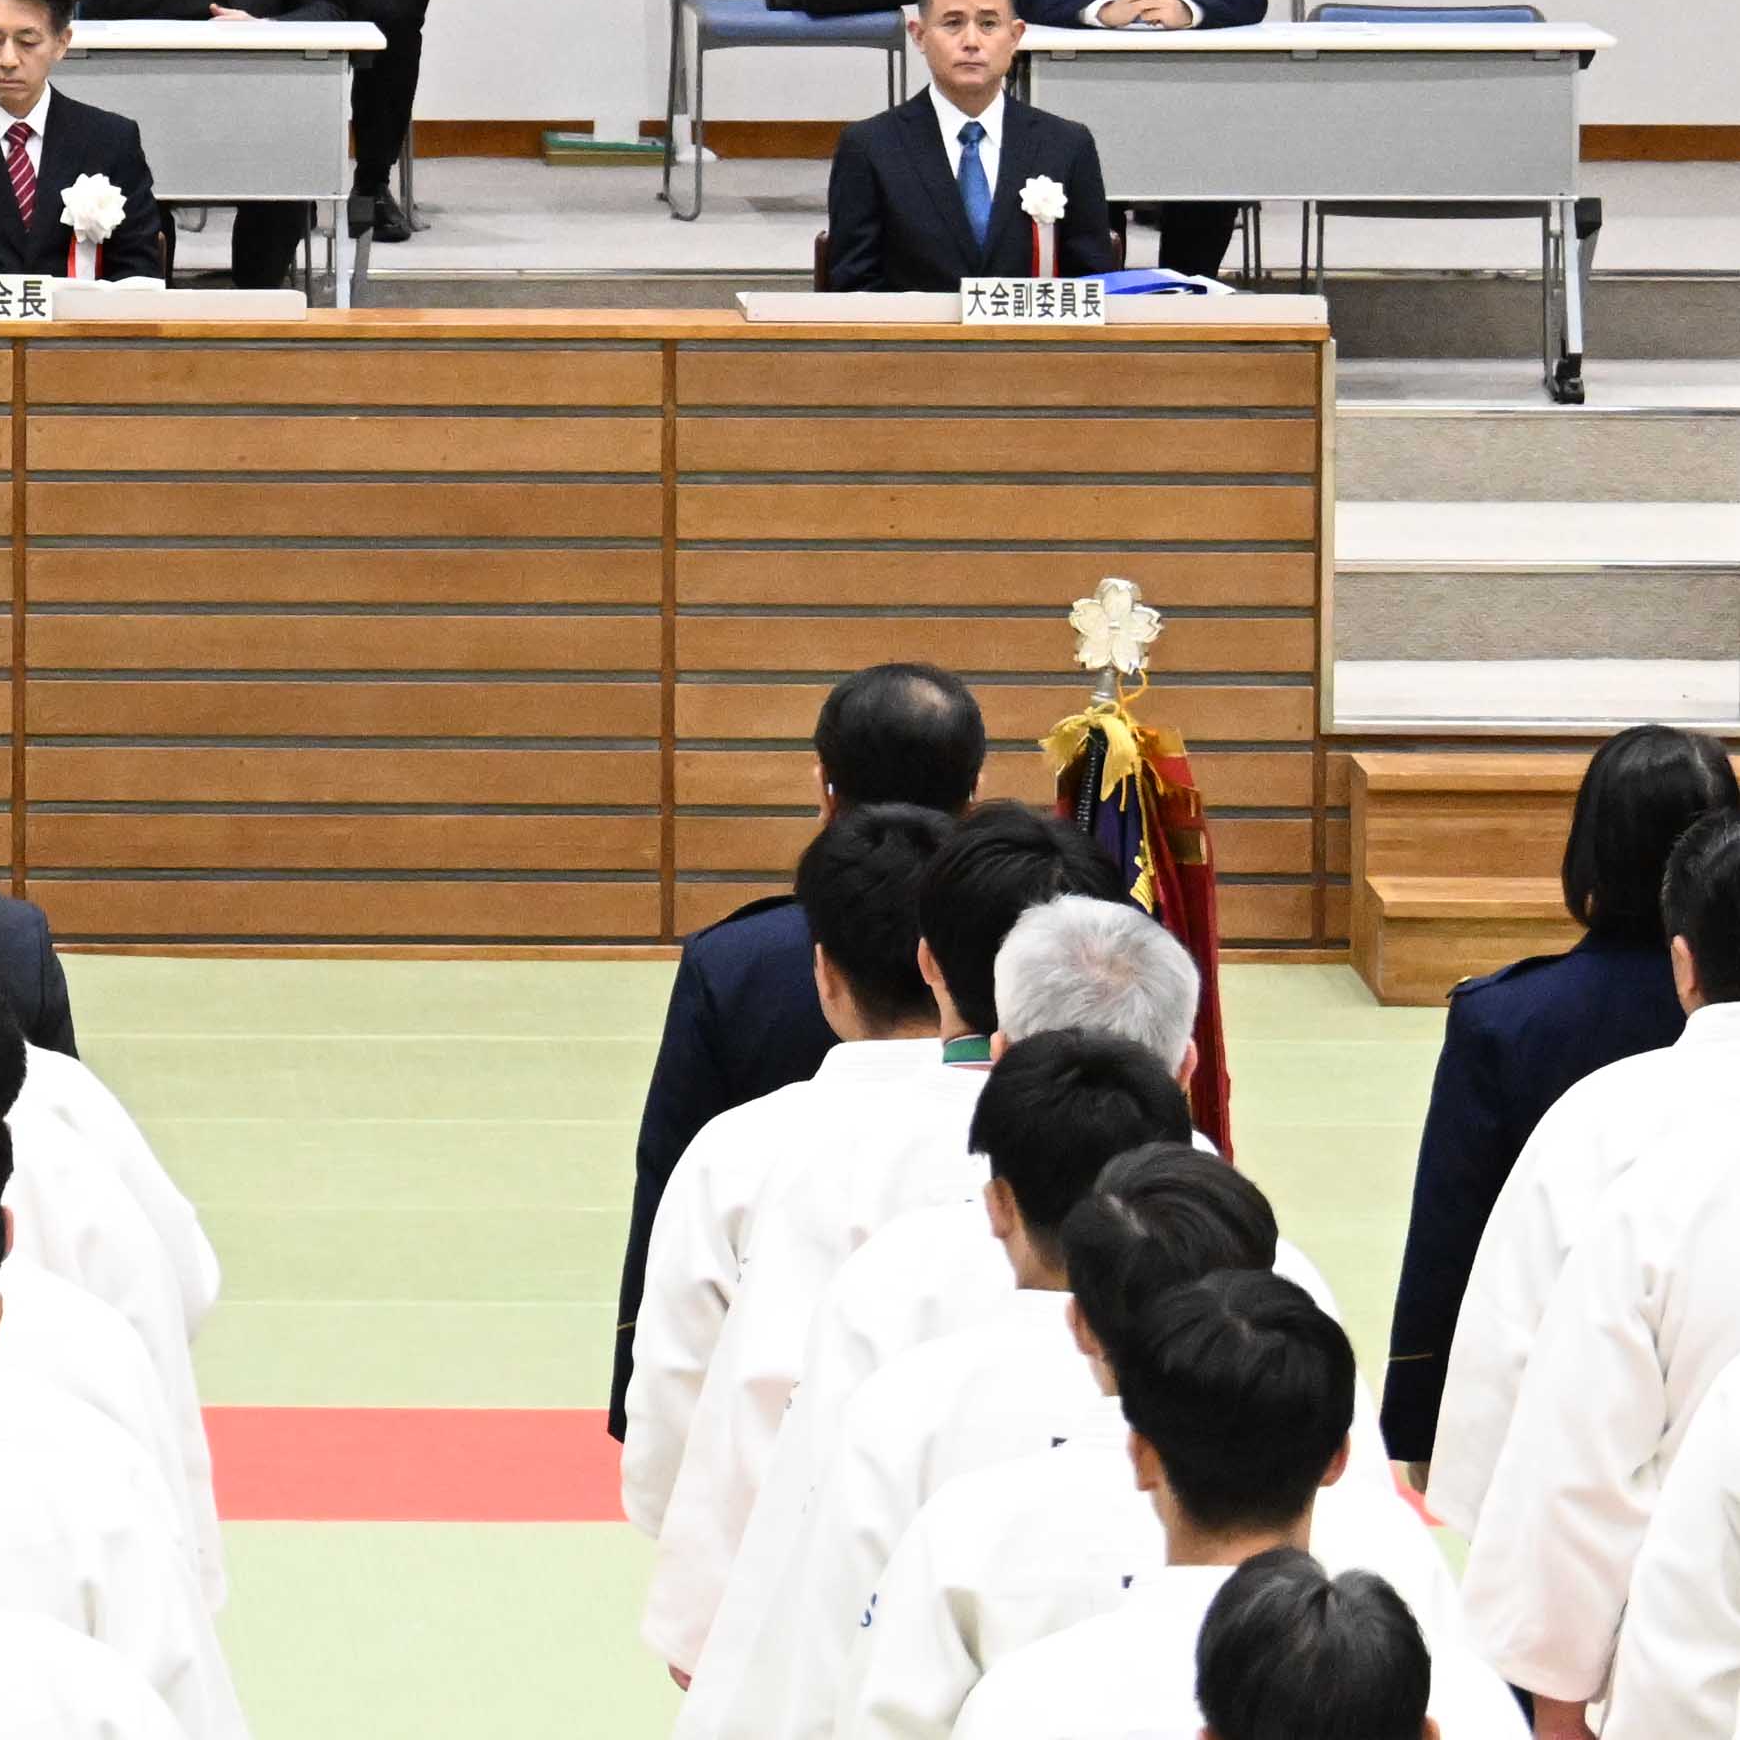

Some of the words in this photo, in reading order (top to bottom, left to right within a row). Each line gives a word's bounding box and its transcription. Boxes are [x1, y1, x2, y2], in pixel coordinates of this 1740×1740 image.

[968, 282, 1101, 318] 大会副委員長
